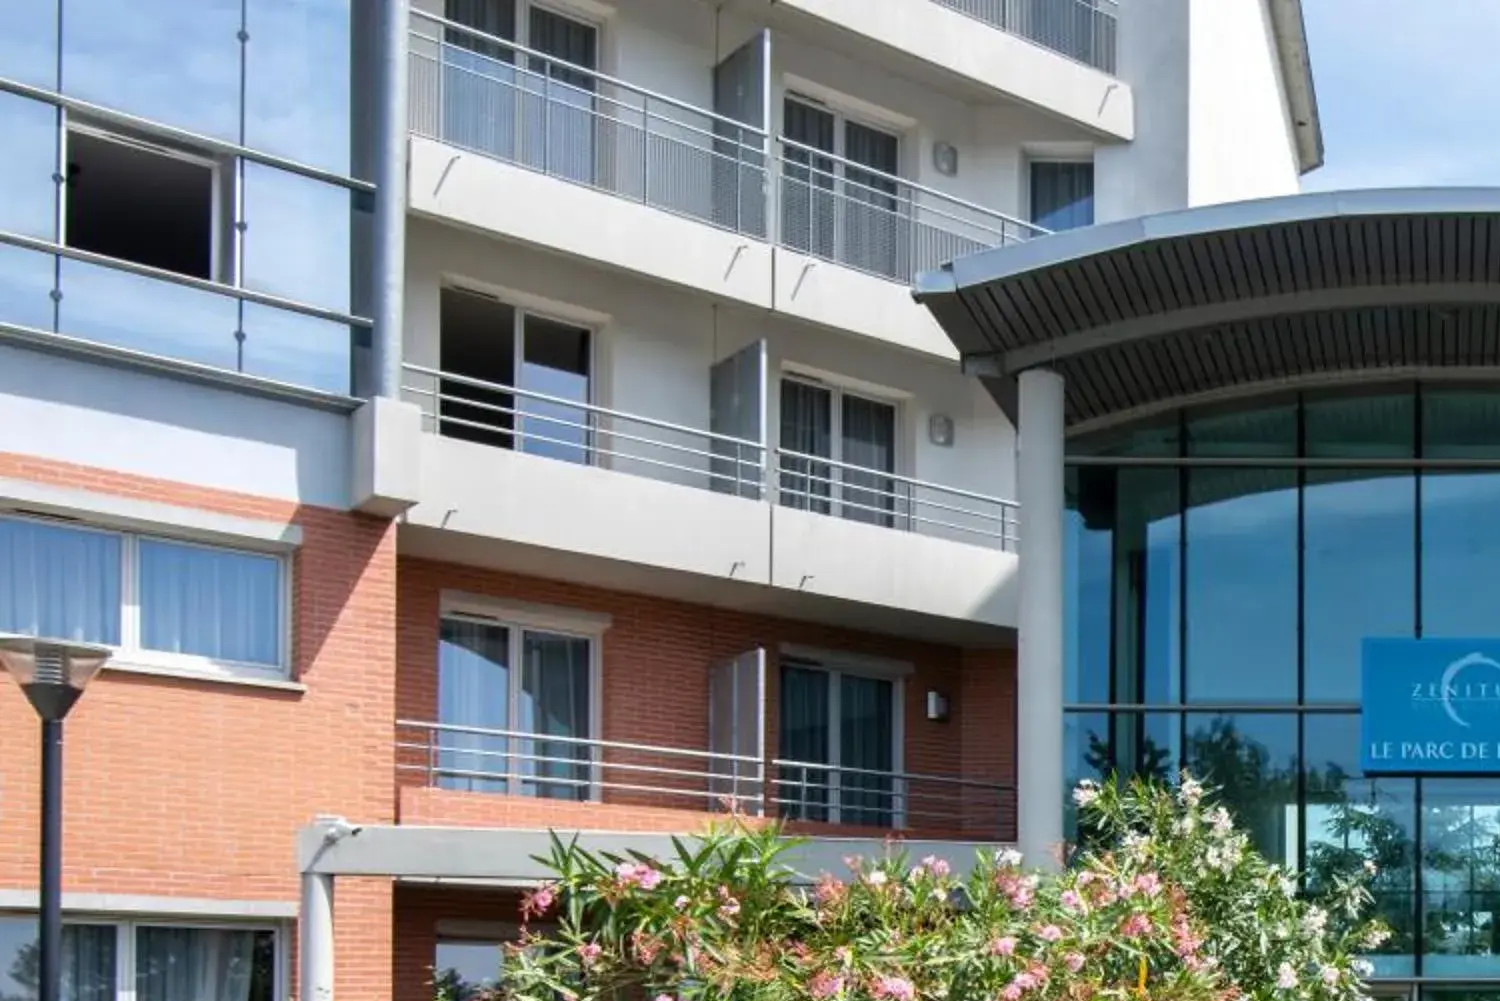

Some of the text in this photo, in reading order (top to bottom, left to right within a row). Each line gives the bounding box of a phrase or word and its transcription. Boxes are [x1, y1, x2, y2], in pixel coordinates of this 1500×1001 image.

[1371, 742, 1393, 760] LE
[1401, 742, 1455, 760] PARC
[1461, 742, 1491, 760] DE
